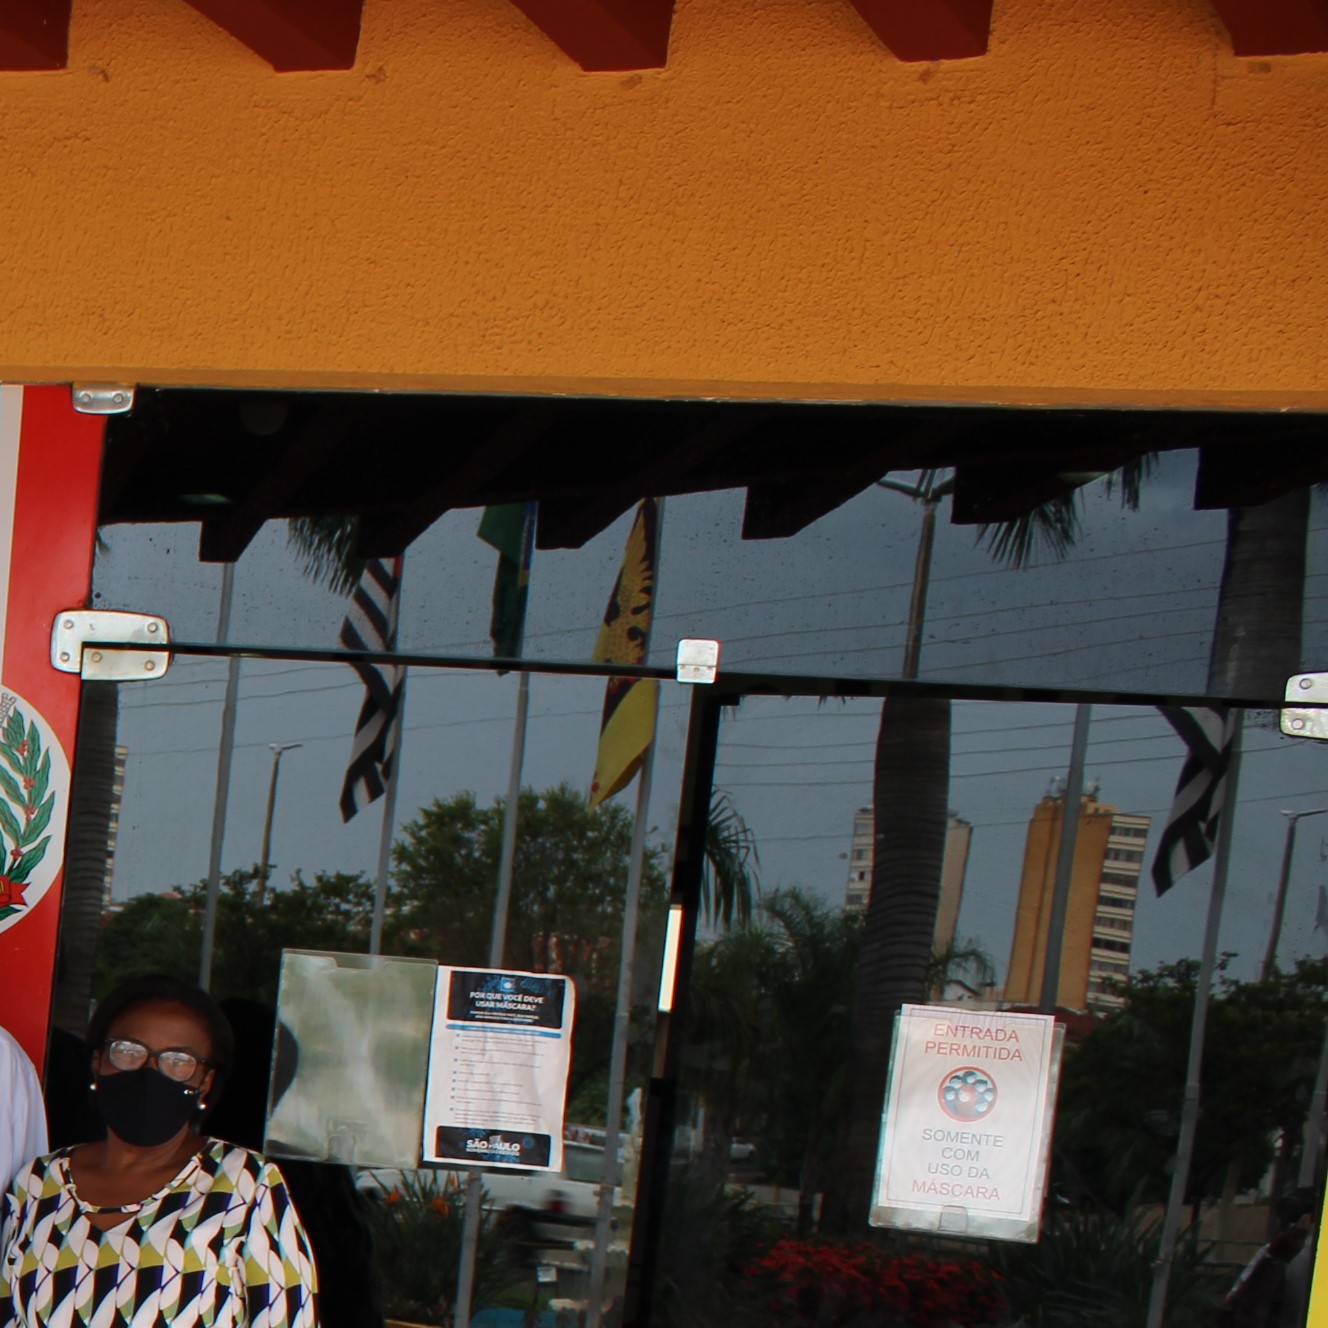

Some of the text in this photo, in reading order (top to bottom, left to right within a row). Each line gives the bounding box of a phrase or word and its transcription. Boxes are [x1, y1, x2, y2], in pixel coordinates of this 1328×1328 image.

[496, 1001, 536, 1011] MÁSCARA?
[502, 994, 522, 1002] VOCÊ
[523, 995, 544, 1004] DEVE
[934, 1023, 1020, 1043] ENTRADA
[924, 1041, 1023, 1061] PERMITIDA
[466, 1138, 488, 1149] SÃO
[922, 1128, 1004, 1148] SOMENTE
[941, 1147, 980, 1162] COM
[928, 1162, 990, 1180] USO DA
[912, 1179, 1000, 1200] MÁSCARA
